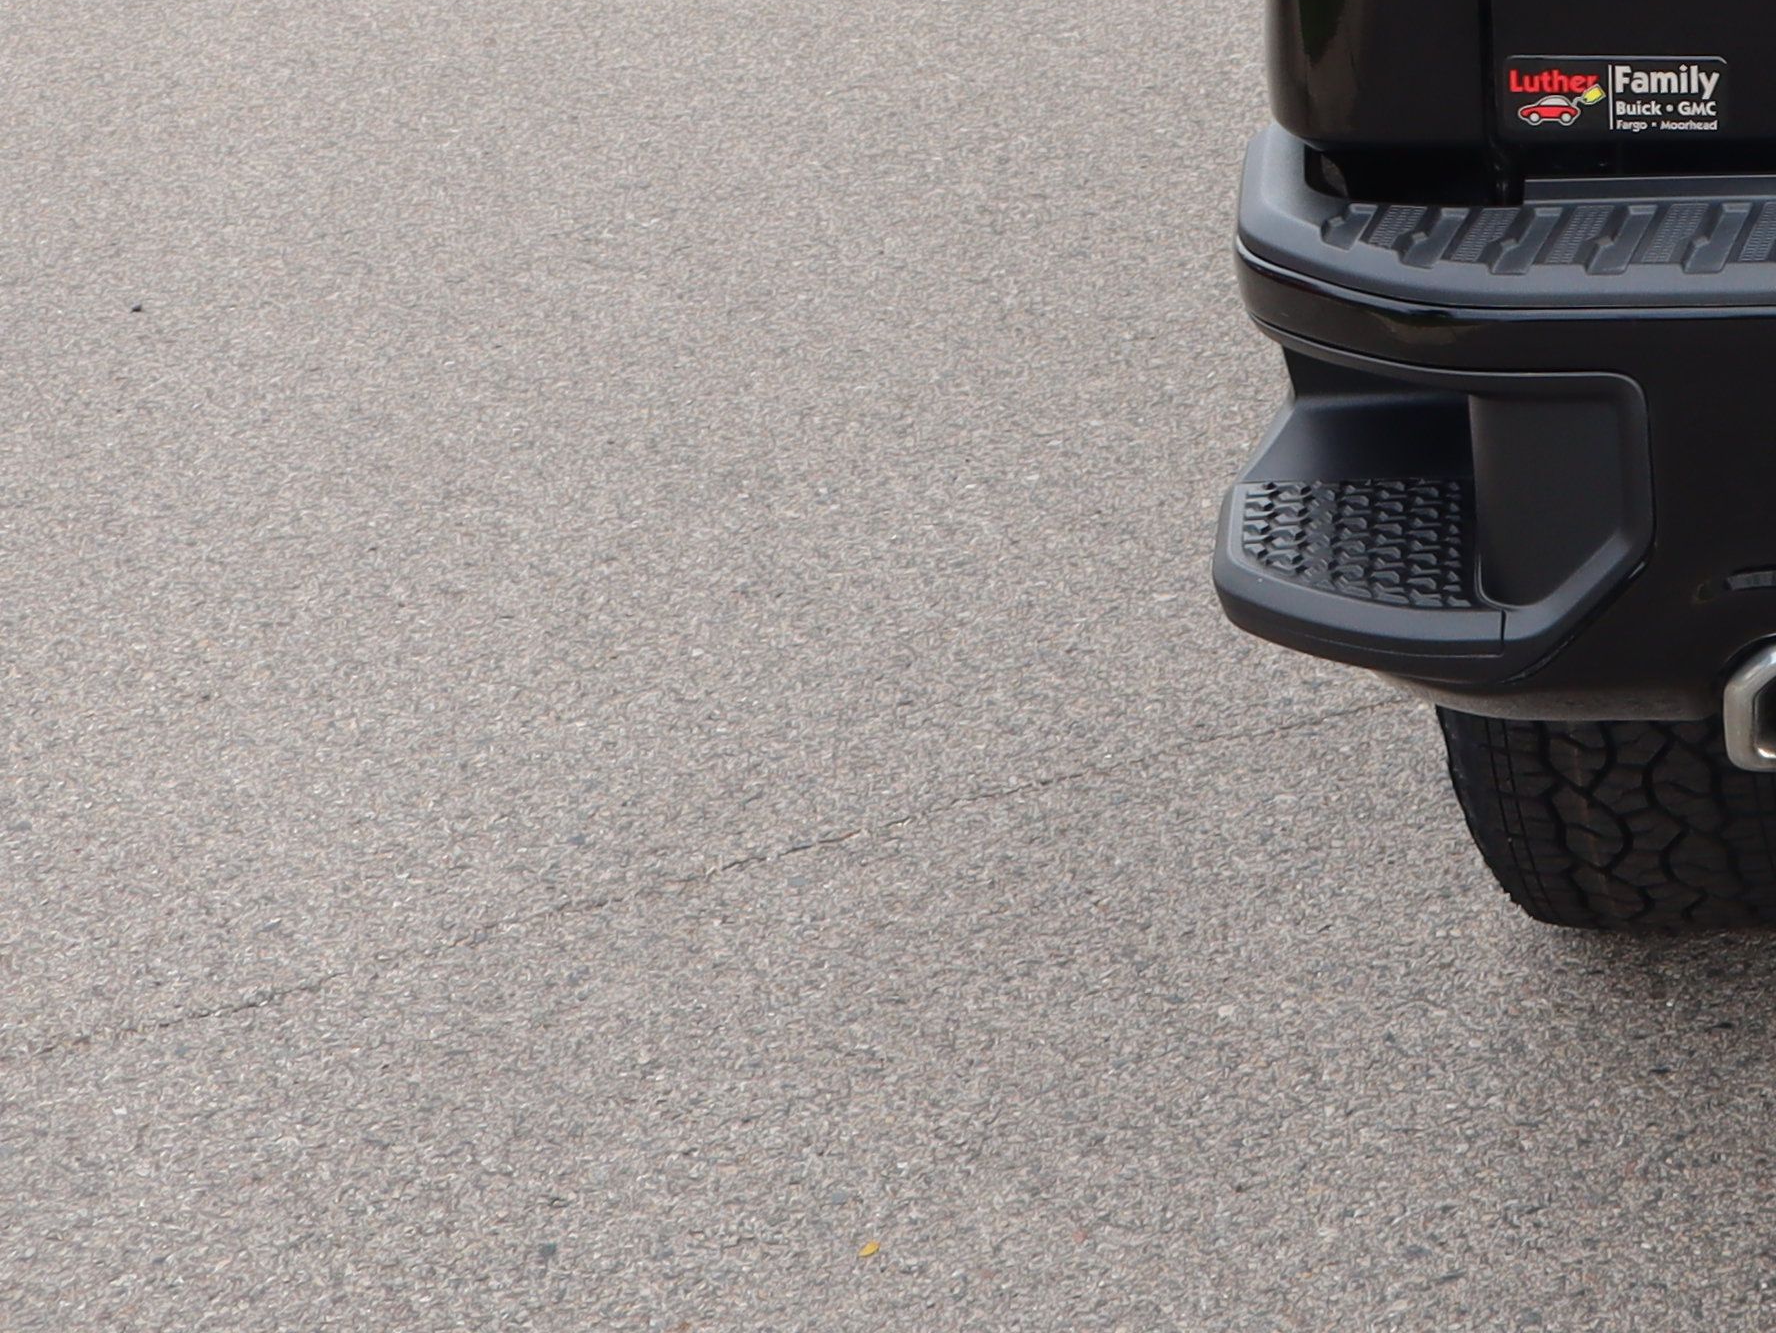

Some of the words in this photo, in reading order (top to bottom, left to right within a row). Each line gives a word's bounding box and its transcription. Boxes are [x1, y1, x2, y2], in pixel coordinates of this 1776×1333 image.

[1509, 68, 1600, 93] Luther
[1614, 64, 1720, 100] Family
[1615, 101, 1662, 116] Buick
[1677, 100, 1717, 116] GMC
[1616, 119, 1648, 132] Fargo
[1660, 119, 1717, 131] Moorhead
